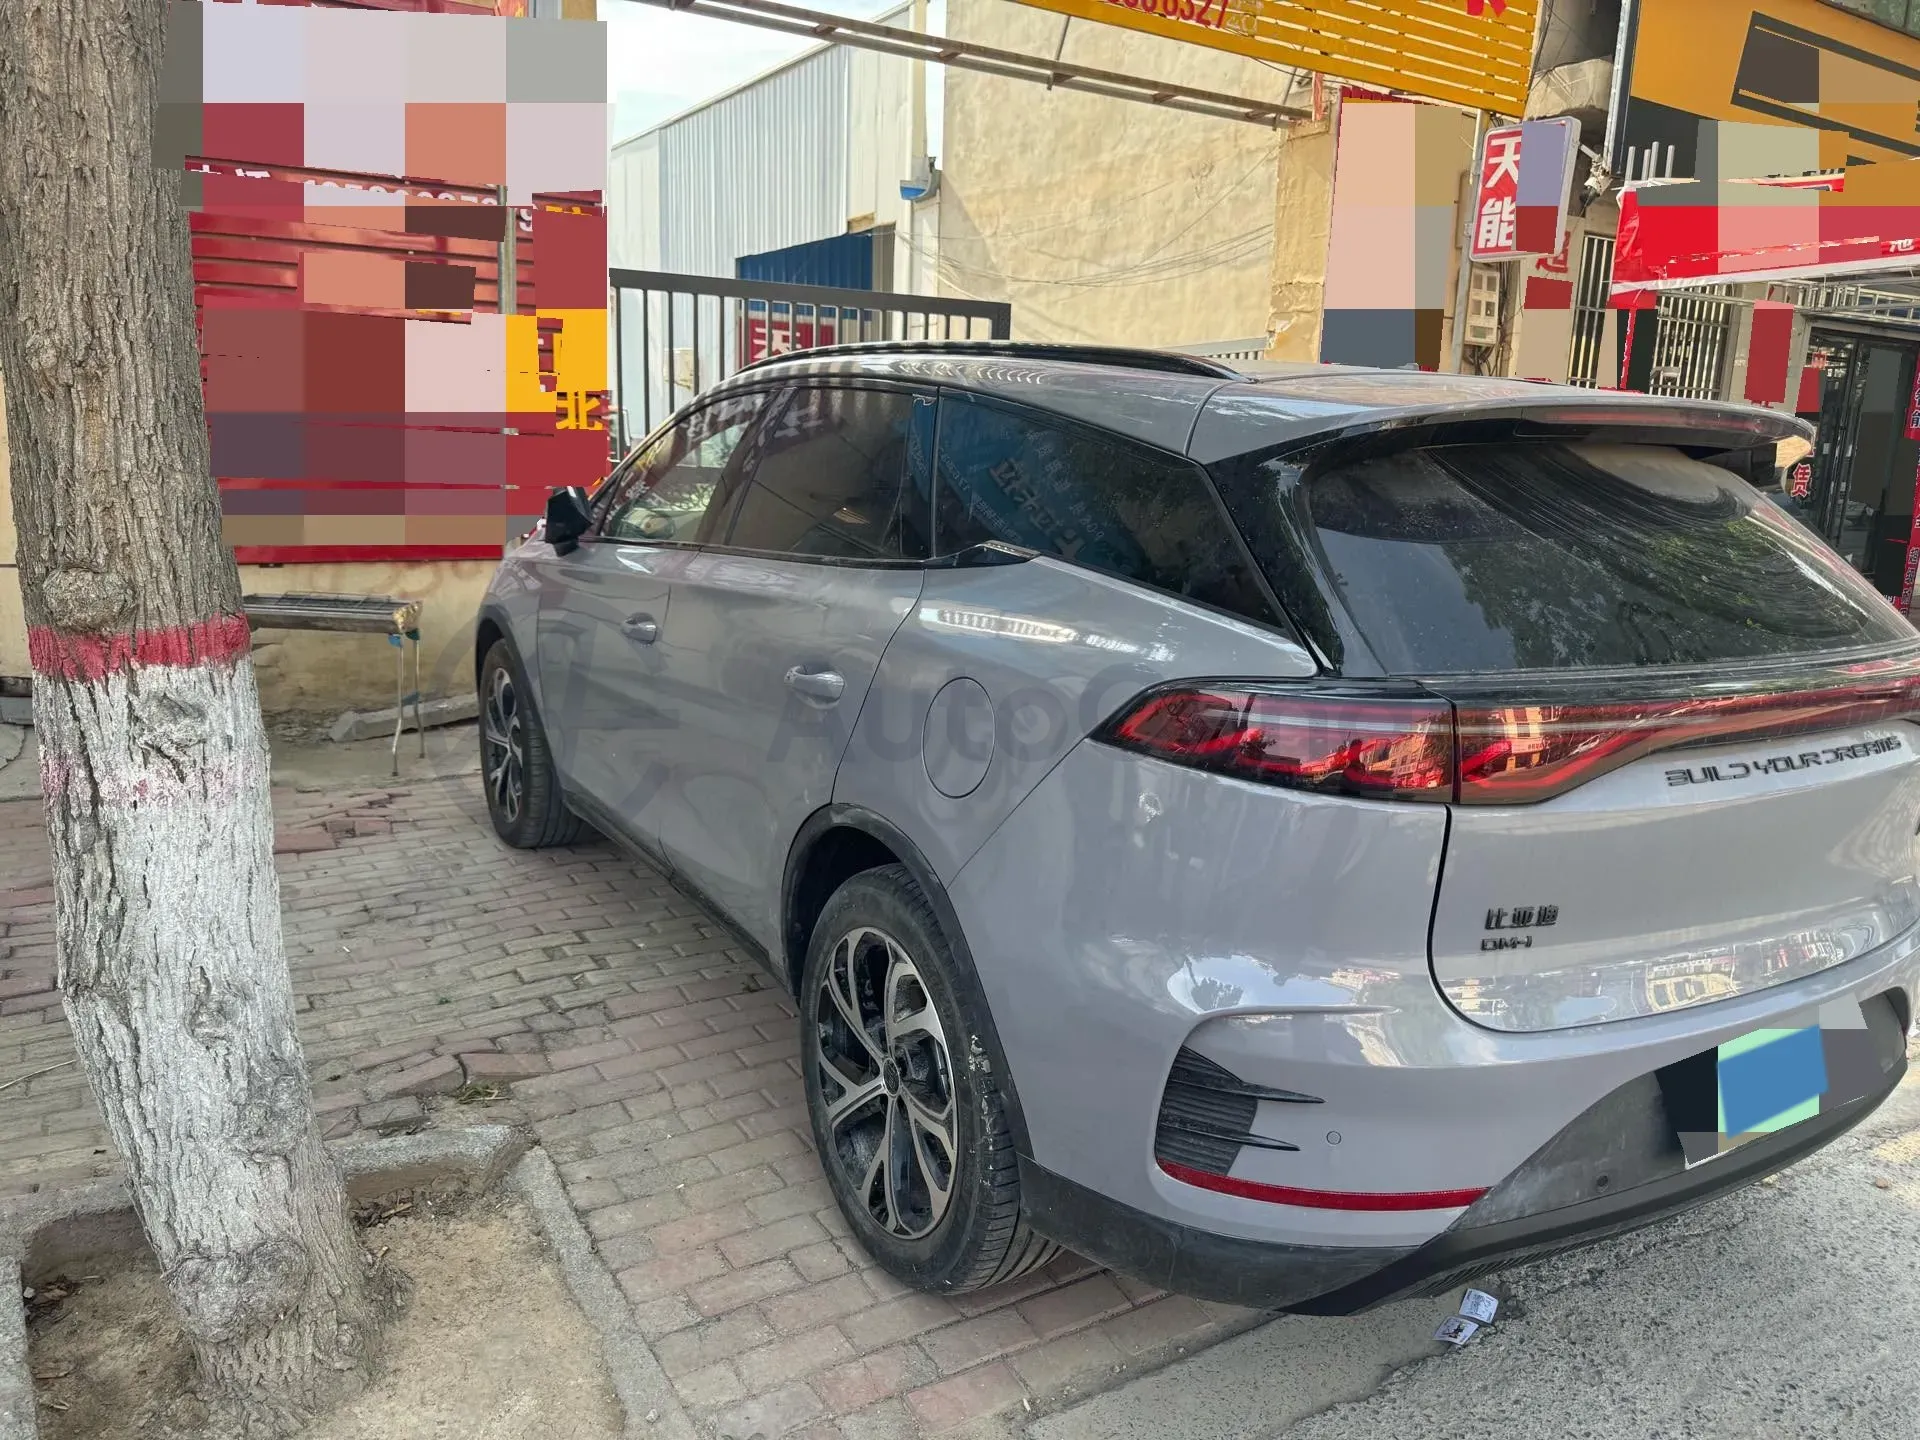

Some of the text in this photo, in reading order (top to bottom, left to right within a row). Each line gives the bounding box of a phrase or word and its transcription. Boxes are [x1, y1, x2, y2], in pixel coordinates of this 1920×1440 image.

[1478, 136, 1522, 249] 天能
[1664, 735, 1902, 787] BUILD YOUR DREAMS
[1484, 904, 1559, 931] 比亚迪
